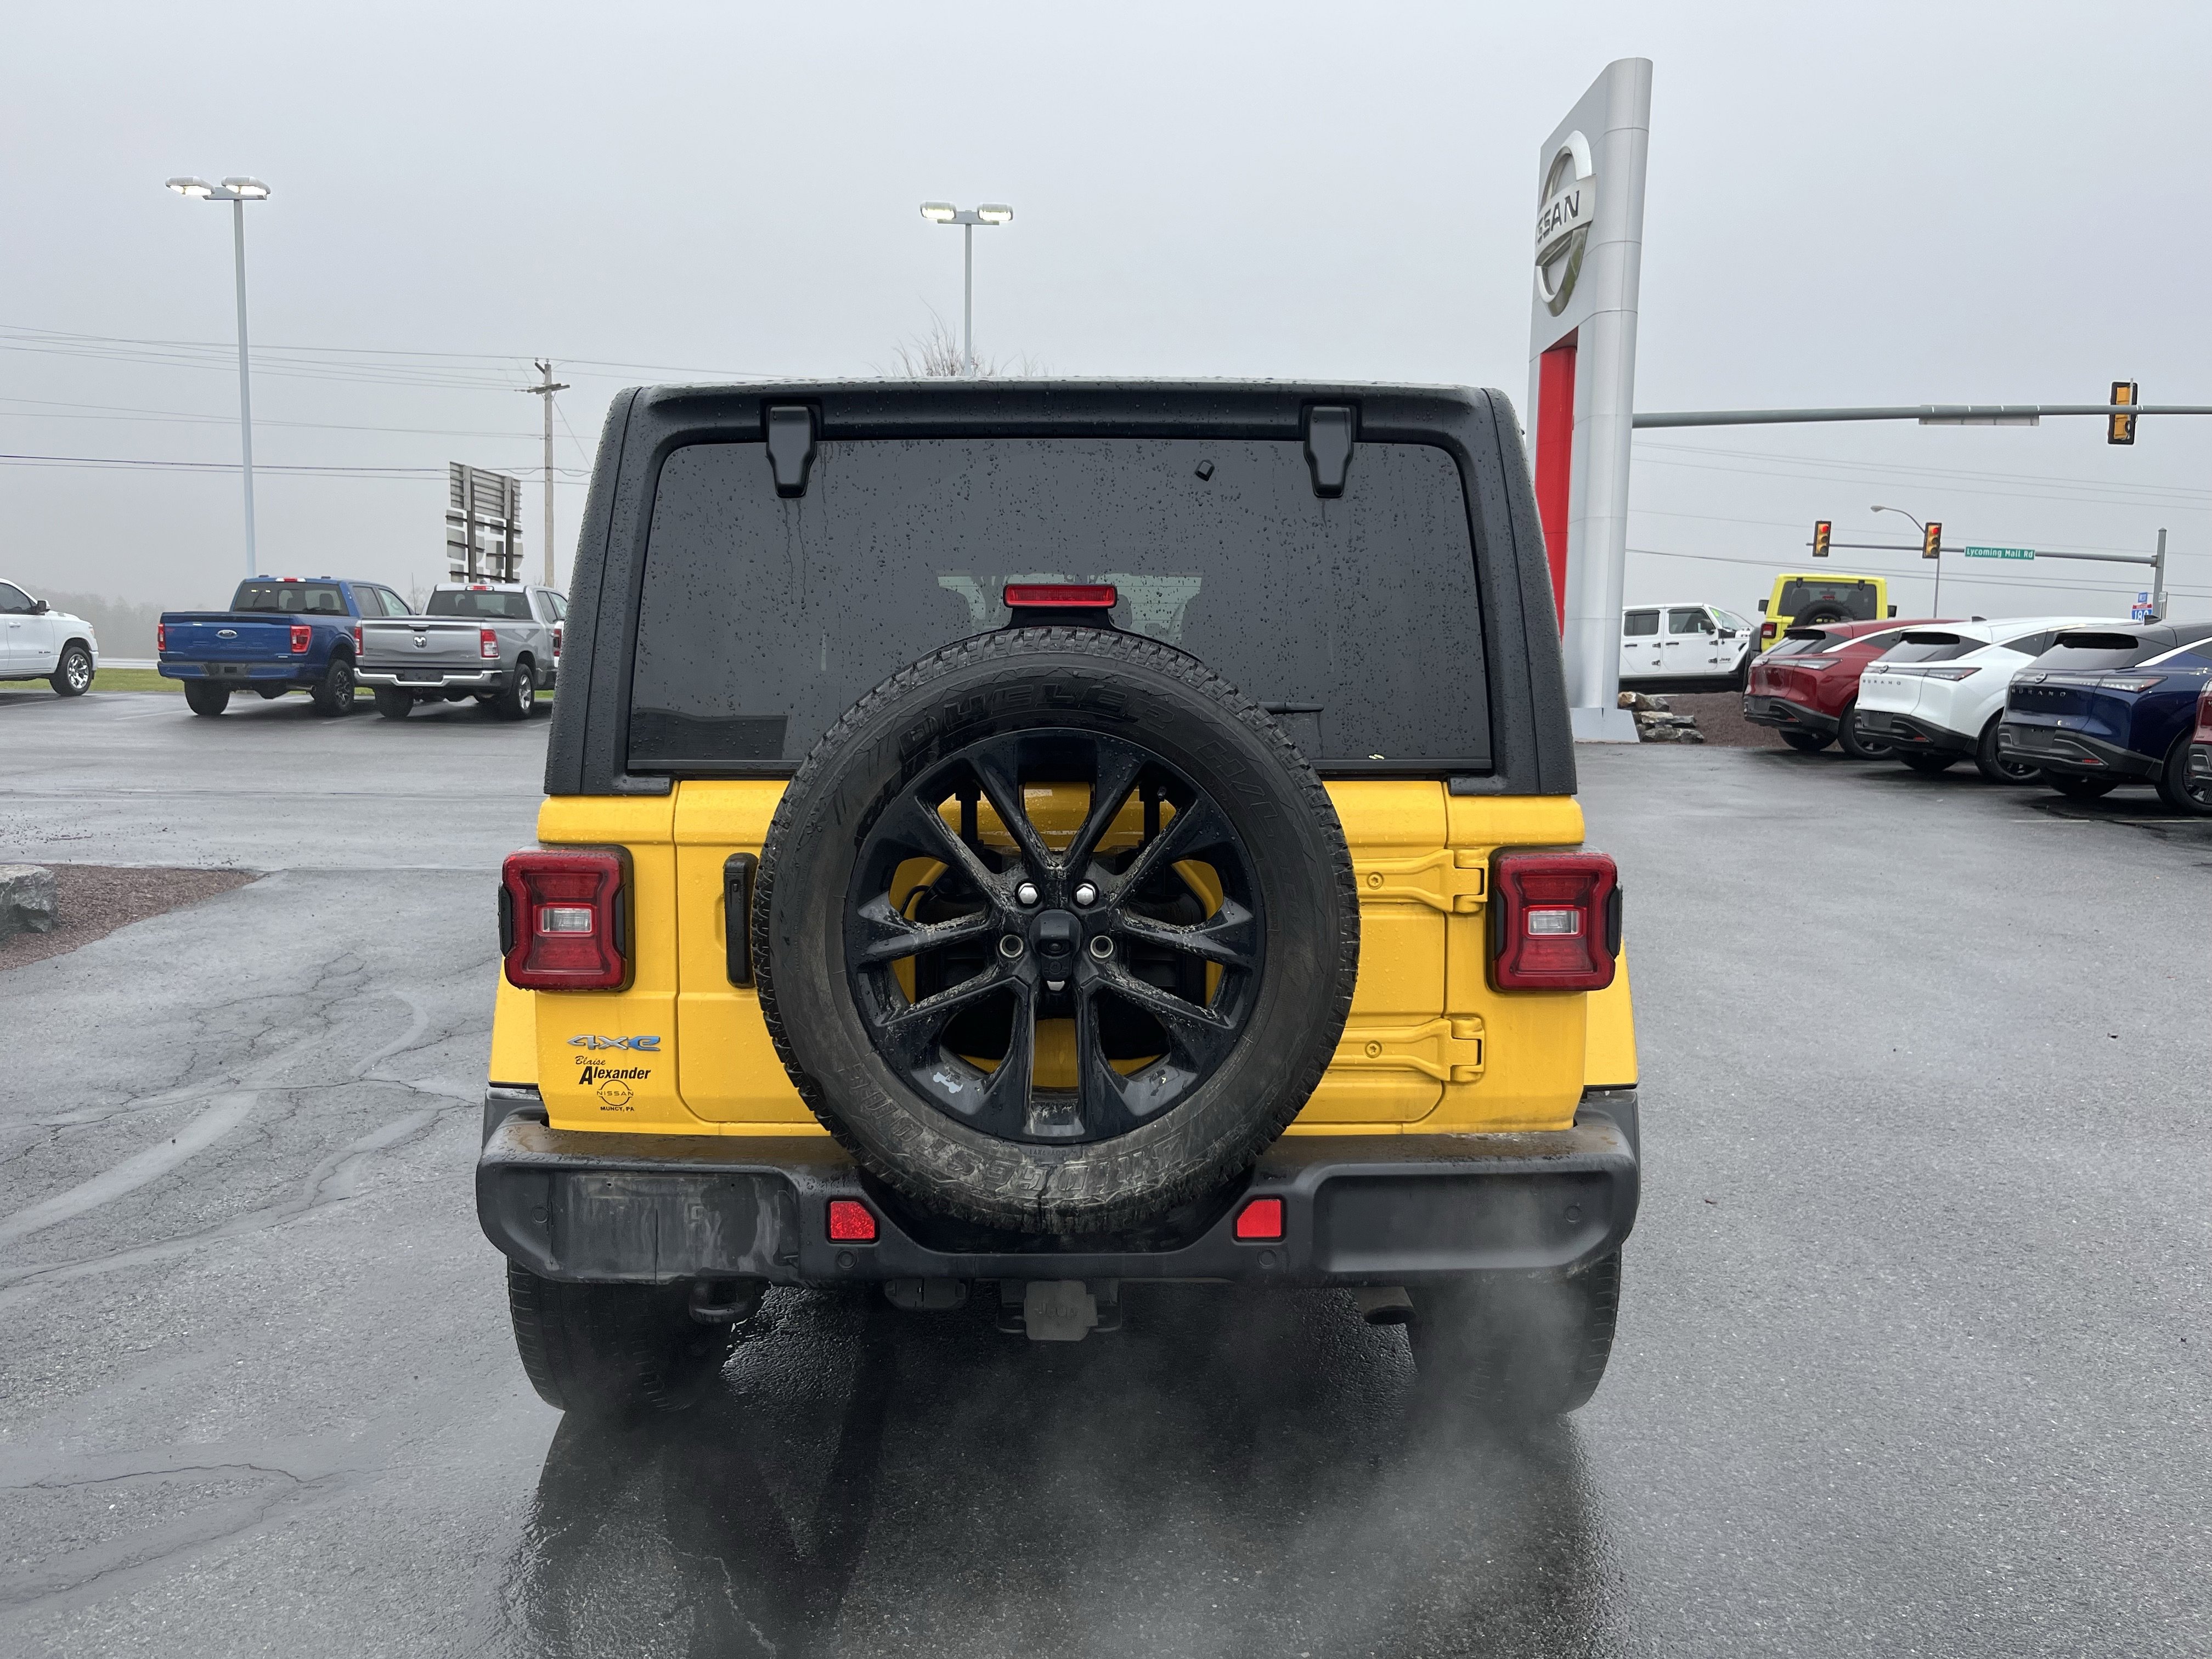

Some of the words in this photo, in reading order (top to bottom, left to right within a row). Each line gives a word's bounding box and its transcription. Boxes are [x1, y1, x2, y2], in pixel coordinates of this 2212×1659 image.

[1967, 548, 2002, 557] Lycoming
[899, 680, 1177, 758] DUELER
[575, 1056, 606, 1065] Blaise
[579, 1066, 651, 1085] Alexander
